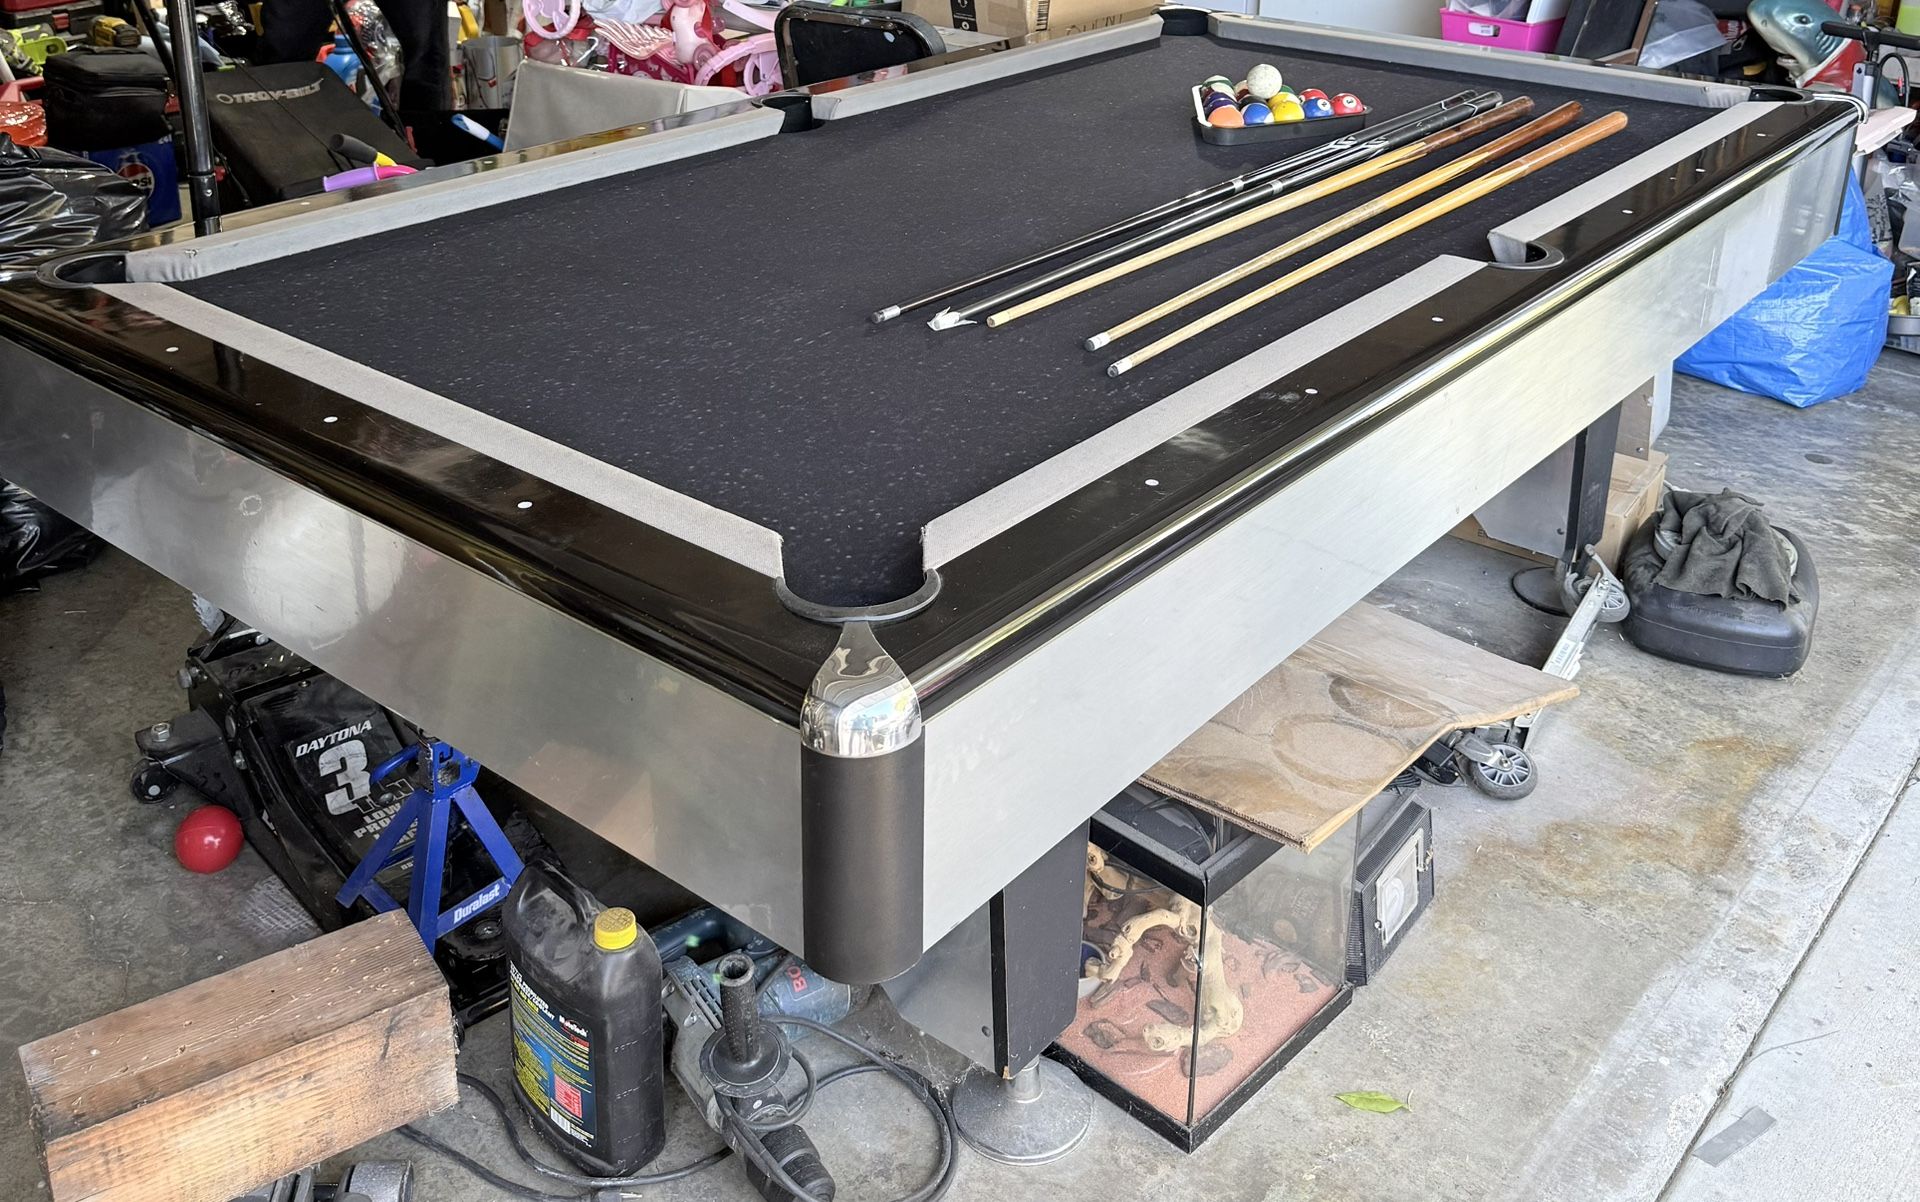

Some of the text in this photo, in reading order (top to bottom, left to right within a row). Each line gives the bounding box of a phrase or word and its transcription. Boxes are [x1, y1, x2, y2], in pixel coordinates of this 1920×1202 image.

[232, 78, 324, 104] TROY-BILT
[296, 719, 373, 758] DAYTONA
[318, 739, 372, 816] 3
[363, 802, 401, 824] LOW
[453, 883, 501, 924] Duralast
